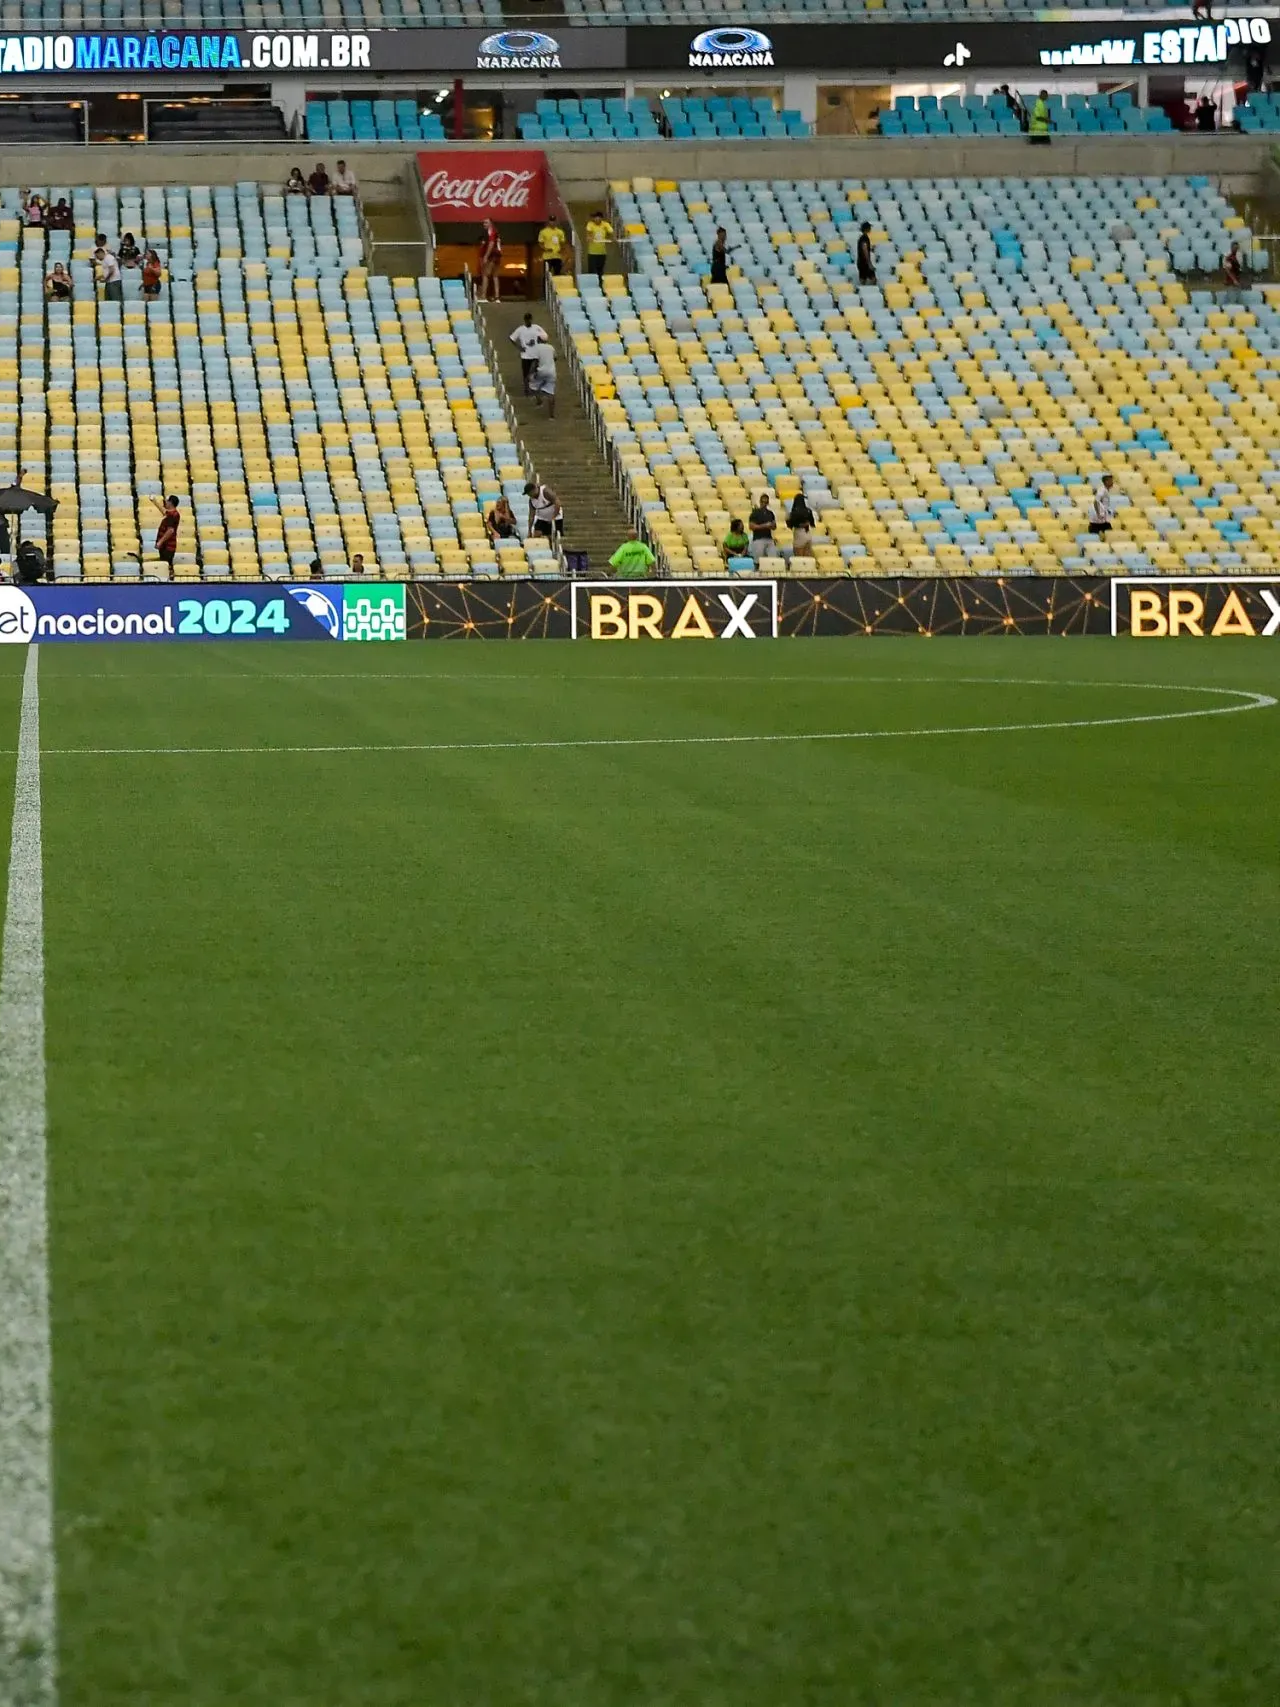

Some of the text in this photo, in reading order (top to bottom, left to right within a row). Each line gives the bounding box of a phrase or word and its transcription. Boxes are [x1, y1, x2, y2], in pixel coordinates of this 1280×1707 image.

[424, 170, 536, 208] Coca-Cola
[178, 600, 290, 634] 2024
[590, 594, 758, 639] BRAX
